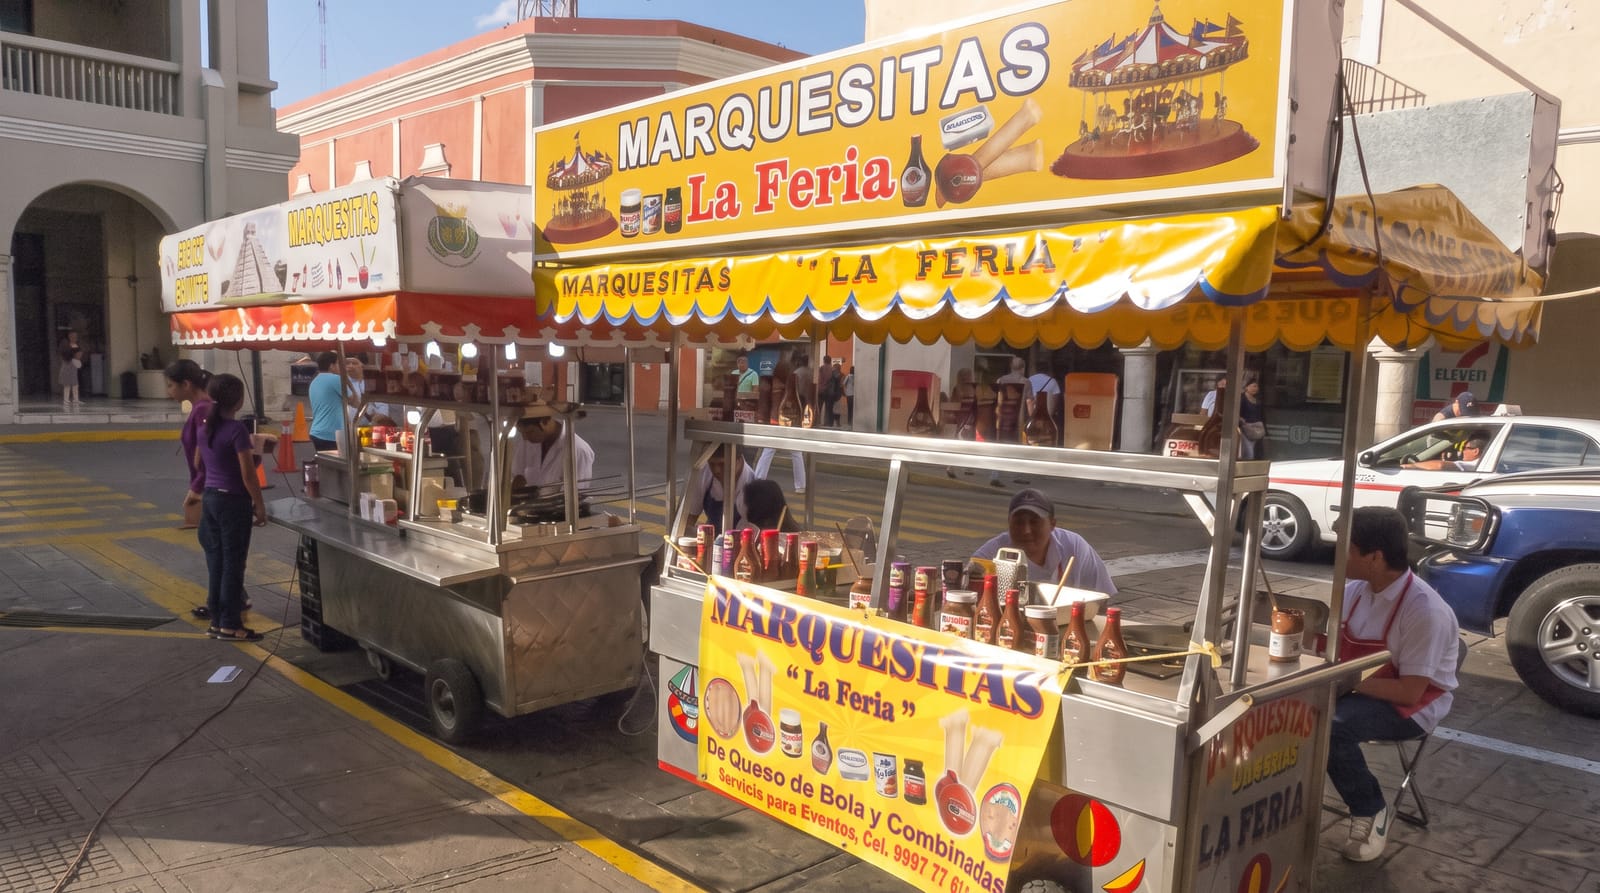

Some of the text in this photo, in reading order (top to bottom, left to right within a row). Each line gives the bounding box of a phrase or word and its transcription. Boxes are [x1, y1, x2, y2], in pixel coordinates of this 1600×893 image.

[616, 21, 1050, 171] MARQUESITAS
[287, 191, 379, 248] MARQUESITAS
[687, 146, 895, 223] La Feria
[562, 258, 731, 296] MARQUESITAS
[709, 584, 1045, 719] MARQUESITAS
[707, 735, 726, 761] De
[729, 748, 785, 787] Queso
[790, 774, 814, 798] de
[821, 783, 865, 819] Bola
[869, 808, 882, 829] y
[887, 813, 1005, 893] Combinadas
[719, 766, 763, 801] Servicis
[767, 793, 797, 817] para
[801, 804, 858, 845] Eventos,
[863, 830, 888, 856] Cel.
[894, 844, 929, 876] 9997
[930, 862, 948, 888] 77
[1199, 781, 1303, 866] LA FERIA
